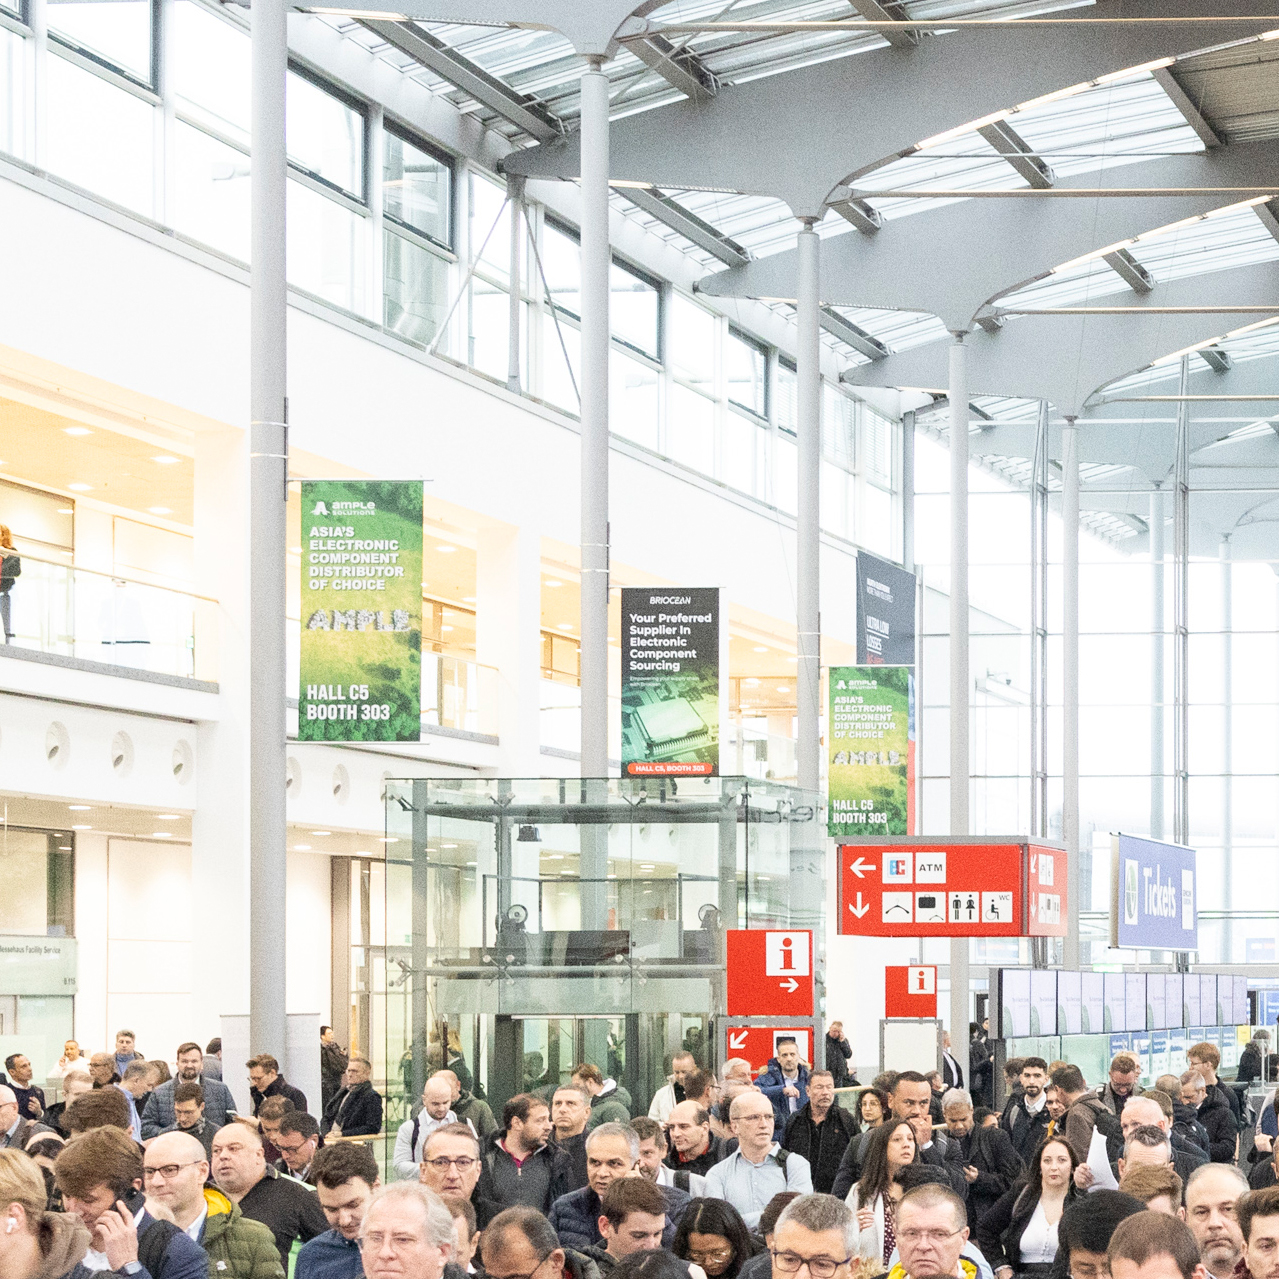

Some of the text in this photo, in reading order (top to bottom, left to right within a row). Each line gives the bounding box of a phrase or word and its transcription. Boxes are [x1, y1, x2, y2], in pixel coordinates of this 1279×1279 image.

[309, 526, 355, 537] ASIA'S
[309, 540, 399, 551] ELECTRONIC
[309, 553, 399, 564] COMPONENT
[309, 566, 405, 577] DISTRIBUTOR
[309, 580, 385, 590] OF CHOICE
[650, 596, 691, 604] BRIOCEAN
[307, 609, 412, 632] AMPLE
[629, 613, 712, 622] Your Preferred
[629, 625, 691, 636] Supplier In
[630, 636, 687, 646] Electronic
[630, 649, 697, 660] Component
[630, 660, 680, 672] Sourcing
[307, 684, 369, 700] HALL C5
[834, 696, 863, 704] ASIA'S
[307, 704, 390, 720] BOOTH 303
[834, 722, 896, 730] DISTRIBUTOR
[833, 751, 901, 766] AMPLE
[833, 800, 874, 810] HALL C5
[833, 813, 887, 823] BOOTH 303
[919, 863, 943, 871] ATM
[1143, 863, 1176, 918] Tickets
[0, 946, 61, 955] essehaus Facility Service
